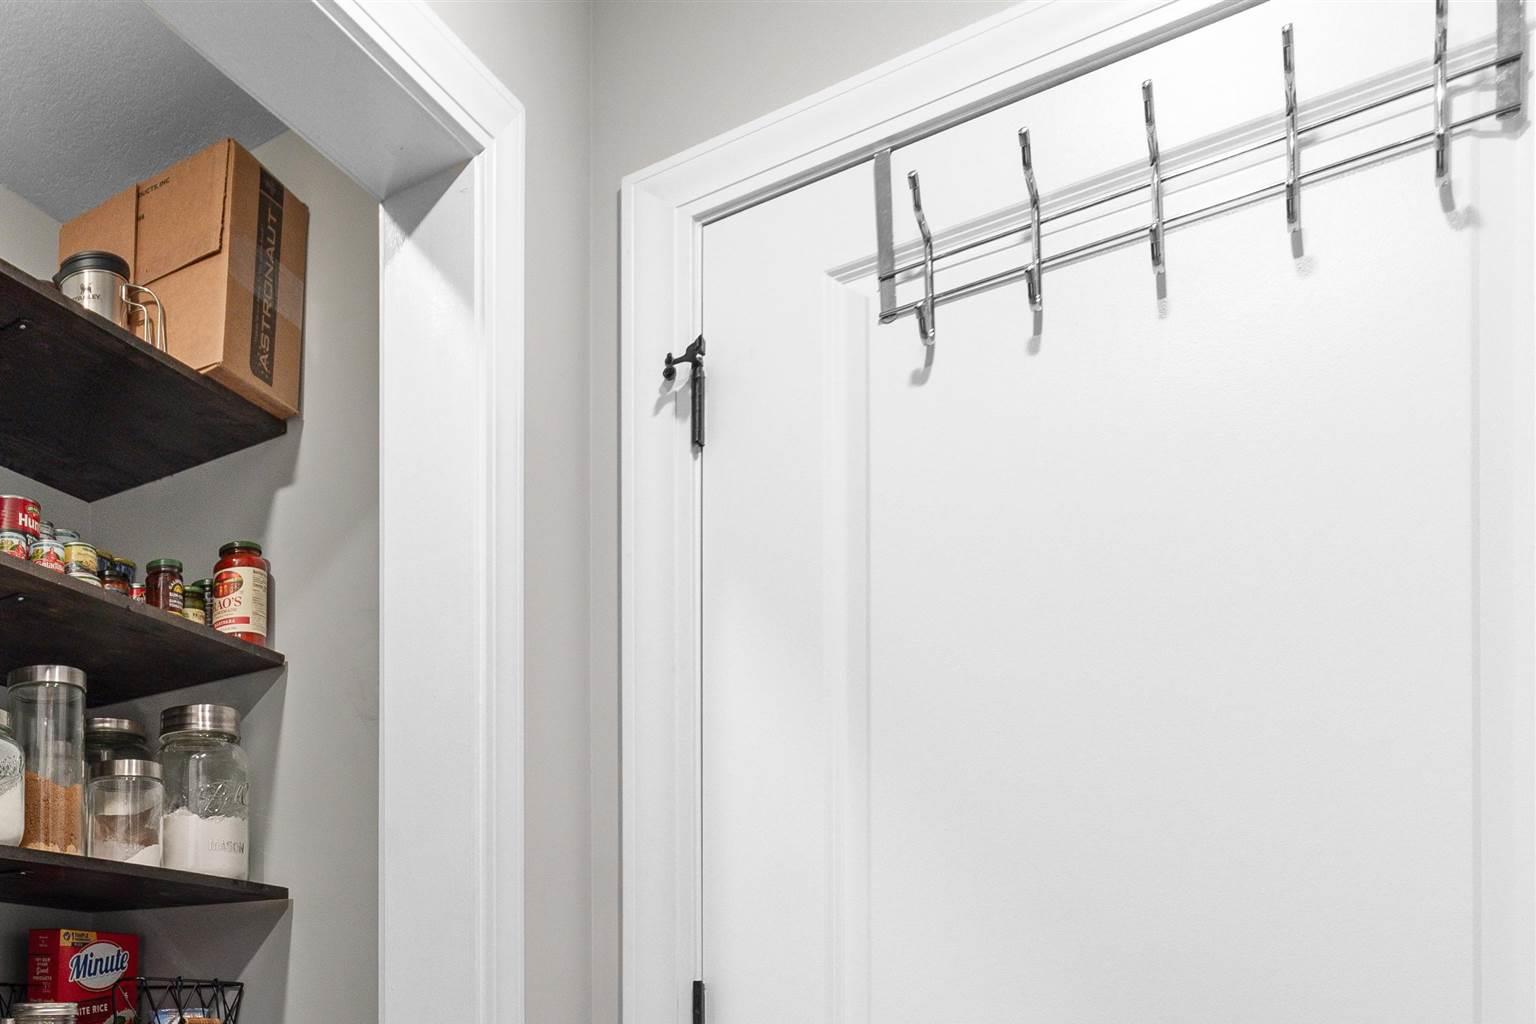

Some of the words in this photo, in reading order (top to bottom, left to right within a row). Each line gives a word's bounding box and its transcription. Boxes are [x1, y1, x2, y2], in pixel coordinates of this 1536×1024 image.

[257, 211, 279, 371] ASTRONAUT
[69, 948, 129, 981] Minute
[76, 1006, 91, 1016] ITE
[91, 1003, 109, 1013] RICE
